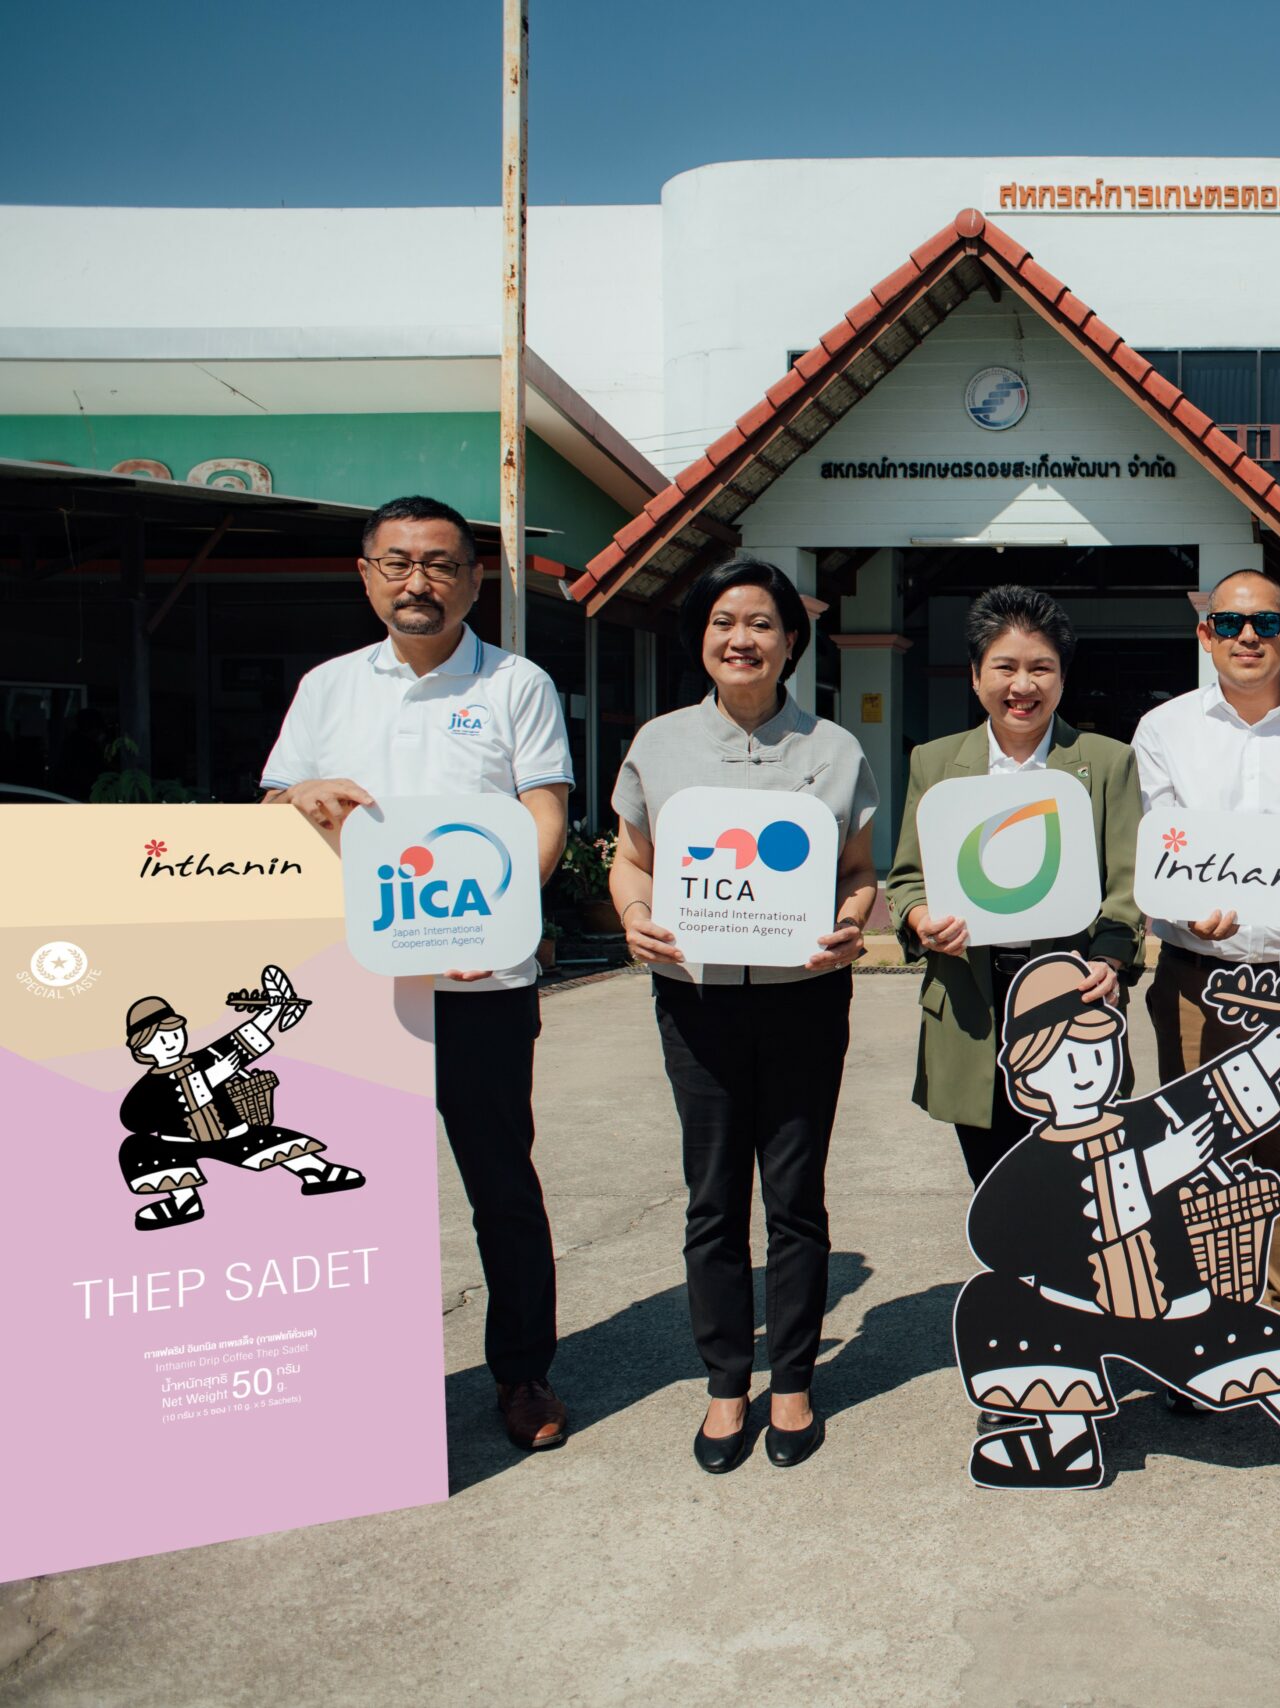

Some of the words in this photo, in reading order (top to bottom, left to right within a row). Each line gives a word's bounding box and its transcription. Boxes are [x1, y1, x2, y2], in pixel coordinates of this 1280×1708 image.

[820, 454, 1121, 480] สหกรณ์การเกษตรดอยสะเก็ดพัฒนา
[1128, 453, 1176, 478] จำกัด
[140, 853, 302, 878] Inthanin
[681, 877, 755, 901] TICA
[679, 907, 728, 919] Thailand
[732, 910, 807, 922] International
[392, 927, 420, 938] Japan
[423, 924, 483, 936] International
[678, 921, 749, 934] Cooperation
[752, 925, 793, 937] Agency
[391, 937, 449, 950] Cooperation
[451, 935, 485, 947] Agency
[16, 970, 65, 1000] SPECIAL
[67, 969, 102, 997] TASTE
[72, 1268, 206, 1319] THEP
[225, 1247, 379, 1301] SADET
[155, 1360, 196, 1373] Inthanin
[199, 1356, 220, 1368] Drip
[222, 1352, 254, 1363] Coffee
[256, 1348, 280, 1359] Thep
[282, 1343, 310, 1355] Sadet
[232, 1367, 273, 1399] 50
[276, 1363, 301, 1376] กรัม
[162, 1396, 183, 1409] Net
[186, 1389, 228, 1405] Weight
[277, 1382, 288, 1393] g.
